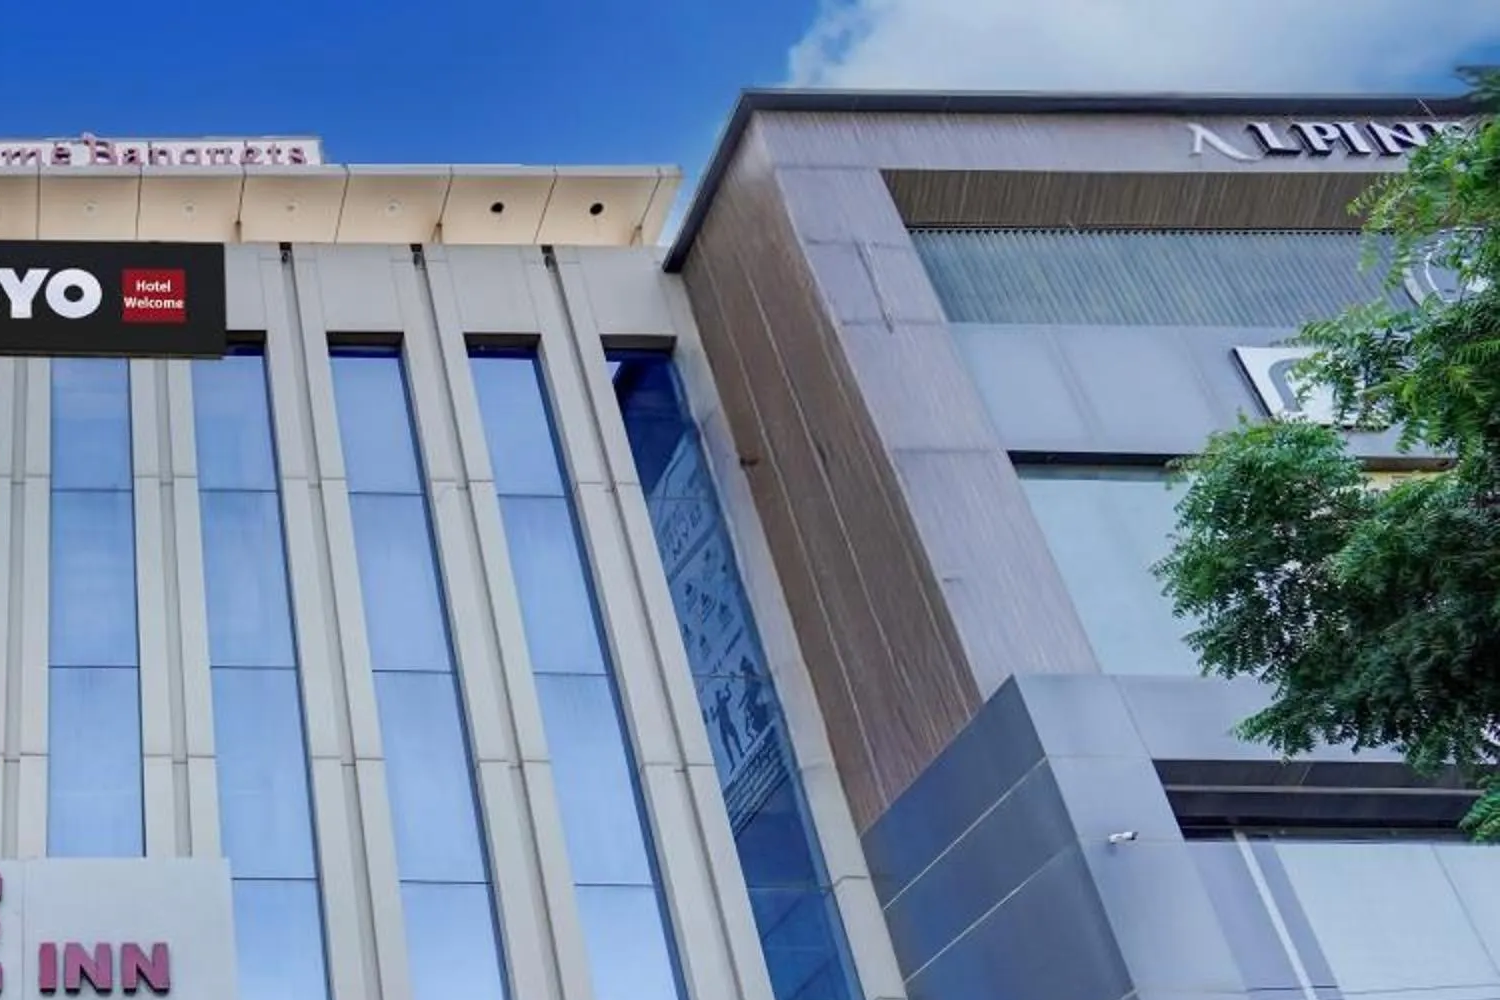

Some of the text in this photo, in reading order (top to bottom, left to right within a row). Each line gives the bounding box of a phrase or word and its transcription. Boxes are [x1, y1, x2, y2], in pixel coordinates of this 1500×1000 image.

[135, 279, 171, 293] Hotel
[123, 296, 184, 309] Welcome
[38, 942, 172, 996] INN
